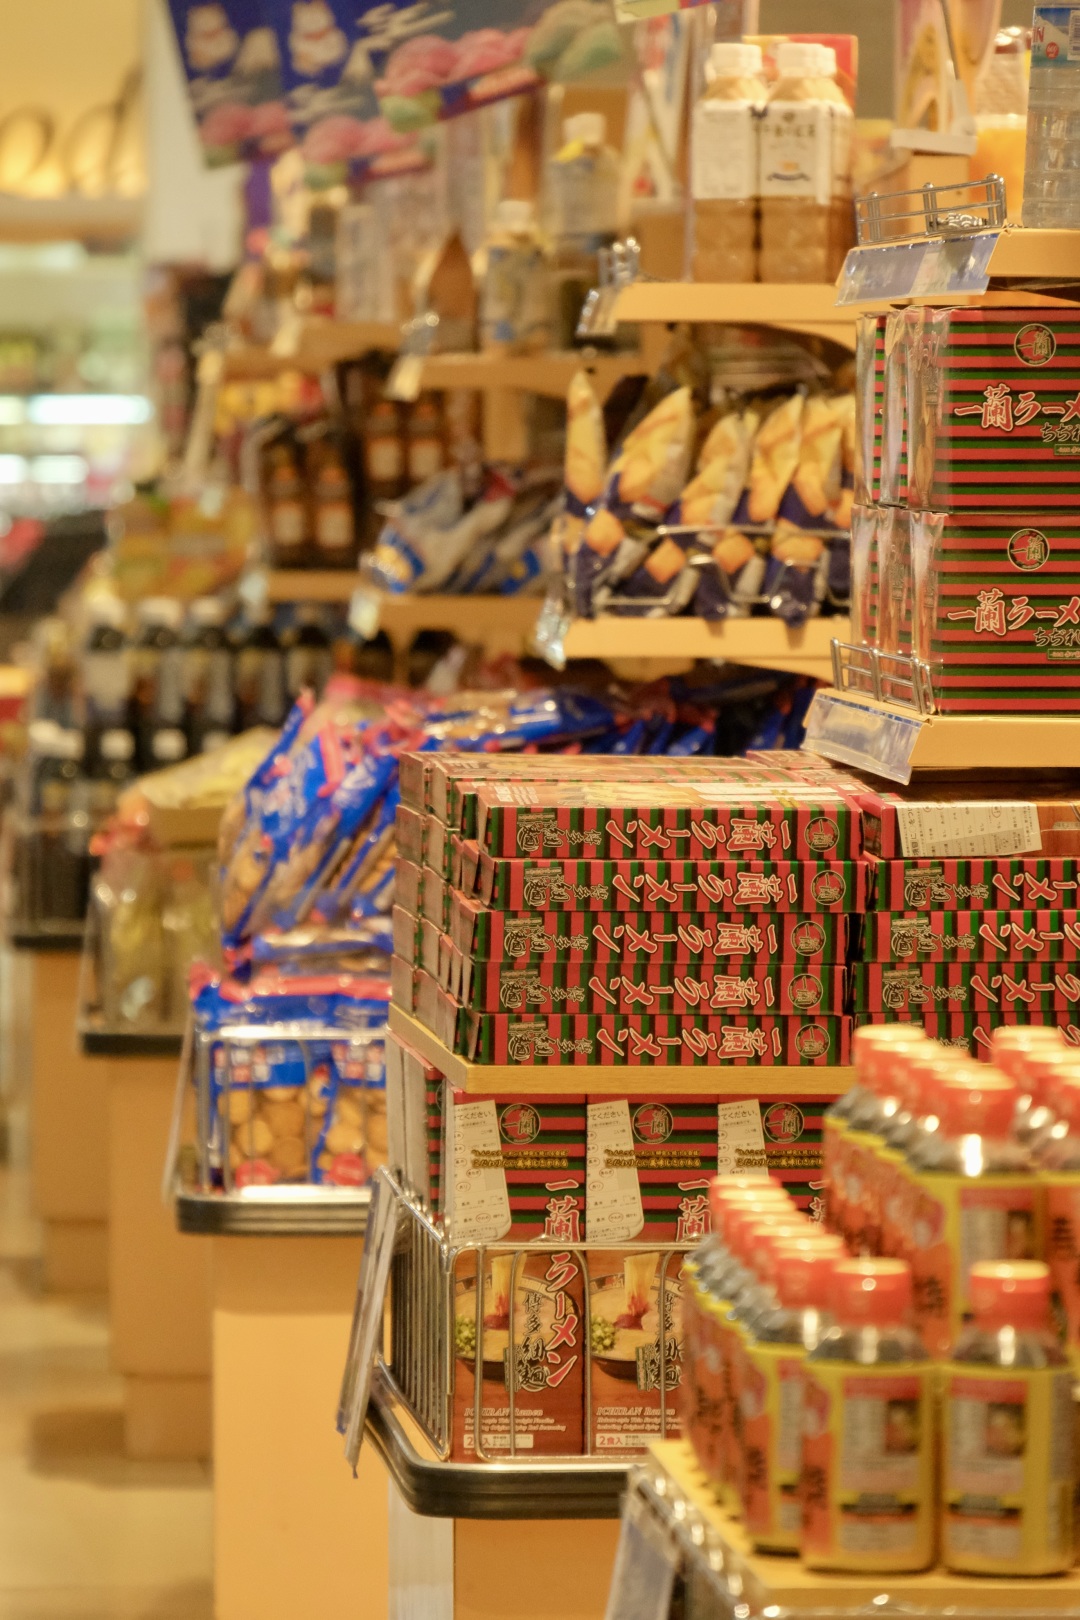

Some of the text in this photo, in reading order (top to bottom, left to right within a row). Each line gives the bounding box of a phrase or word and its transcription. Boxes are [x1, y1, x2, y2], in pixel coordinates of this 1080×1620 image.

[606, 818, 791, 852] 一蘭ラーメン
[613, 873, 798, 905] 一蘭ラーメン
[593, 922, 778, 956] 一蘭ラーメン
[589, 974, 774, 1009] 一蘭ラーメン
[597, 1026, 782, 1060] 一蘭ラーメン
[467, 1436, 490, 1446] 2入
